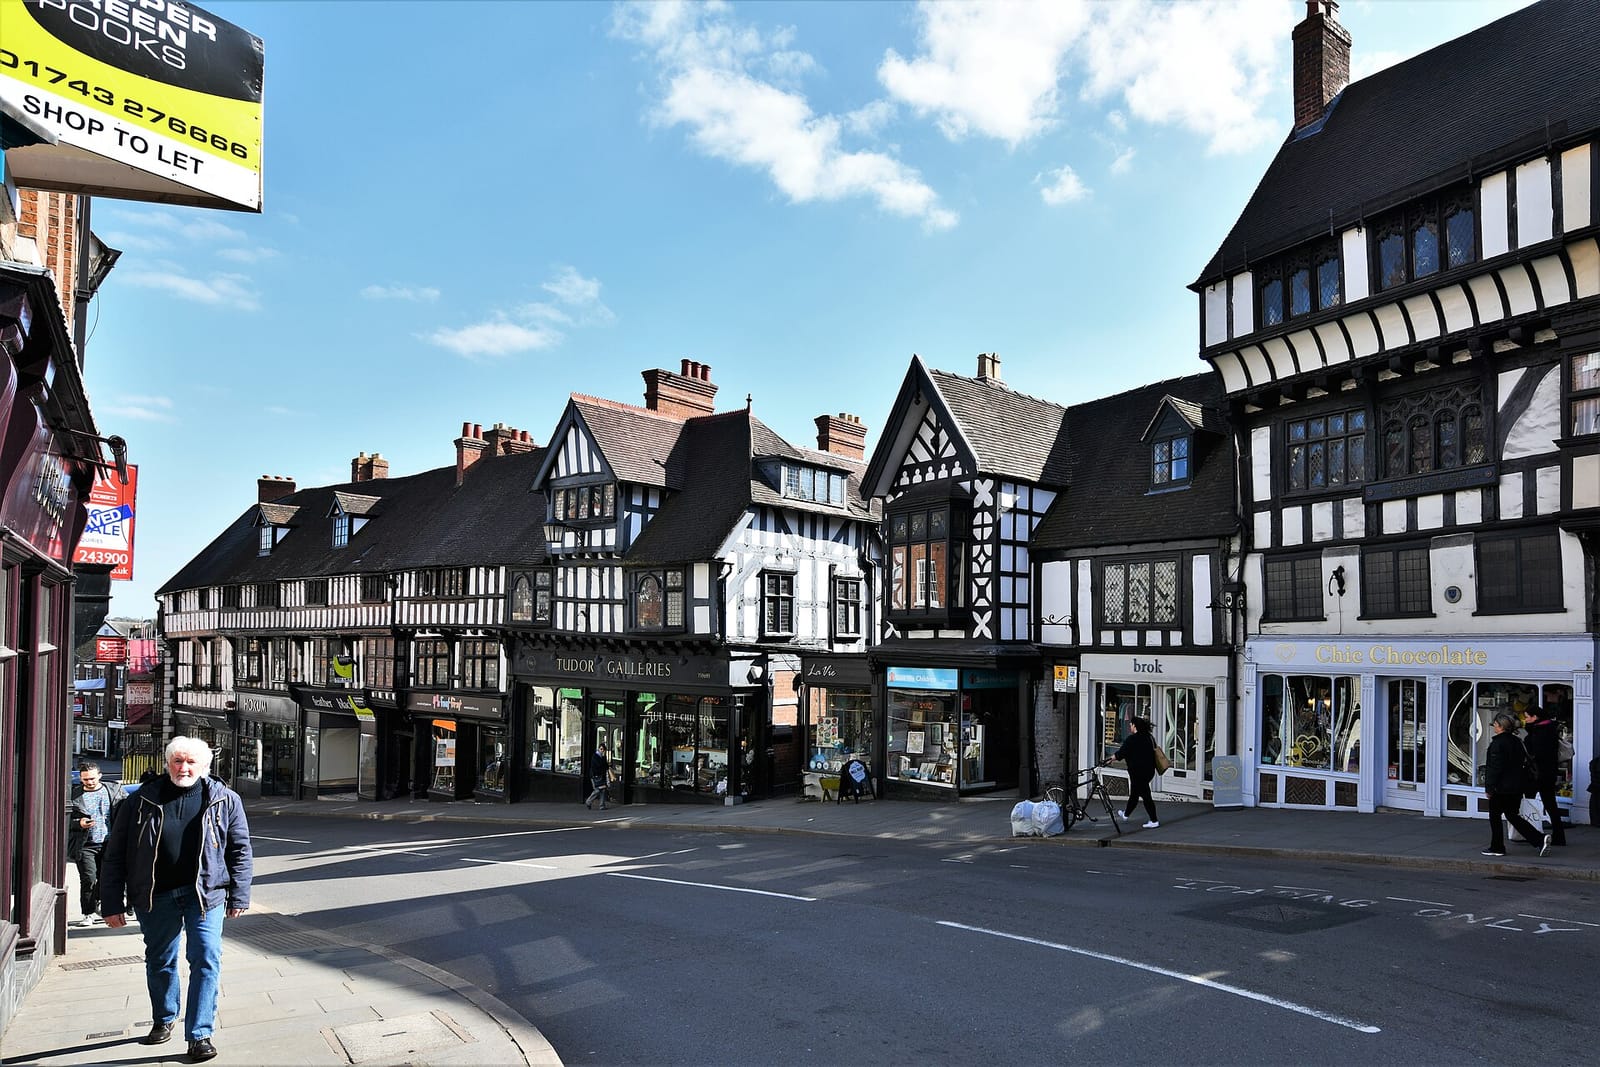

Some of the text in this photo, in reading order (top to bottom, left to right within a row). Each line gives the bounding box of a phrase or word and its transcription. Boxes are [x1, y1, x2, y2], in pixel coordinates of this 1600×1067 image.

[115, 0, 217, 42] PER
[0, 50, 248, 160] 01743 276666
[23, 93, 205, 176] SHOP TO LET
[79, 549, 128, 565] 243900
[556, 657, 672, 678] TUDOR GALLERIES
[1132, 658, 1164, 674] brok
[1315, 645, 1488, 666] Chic Chocolate
[1413, 908, 1583, 935] ONLY
